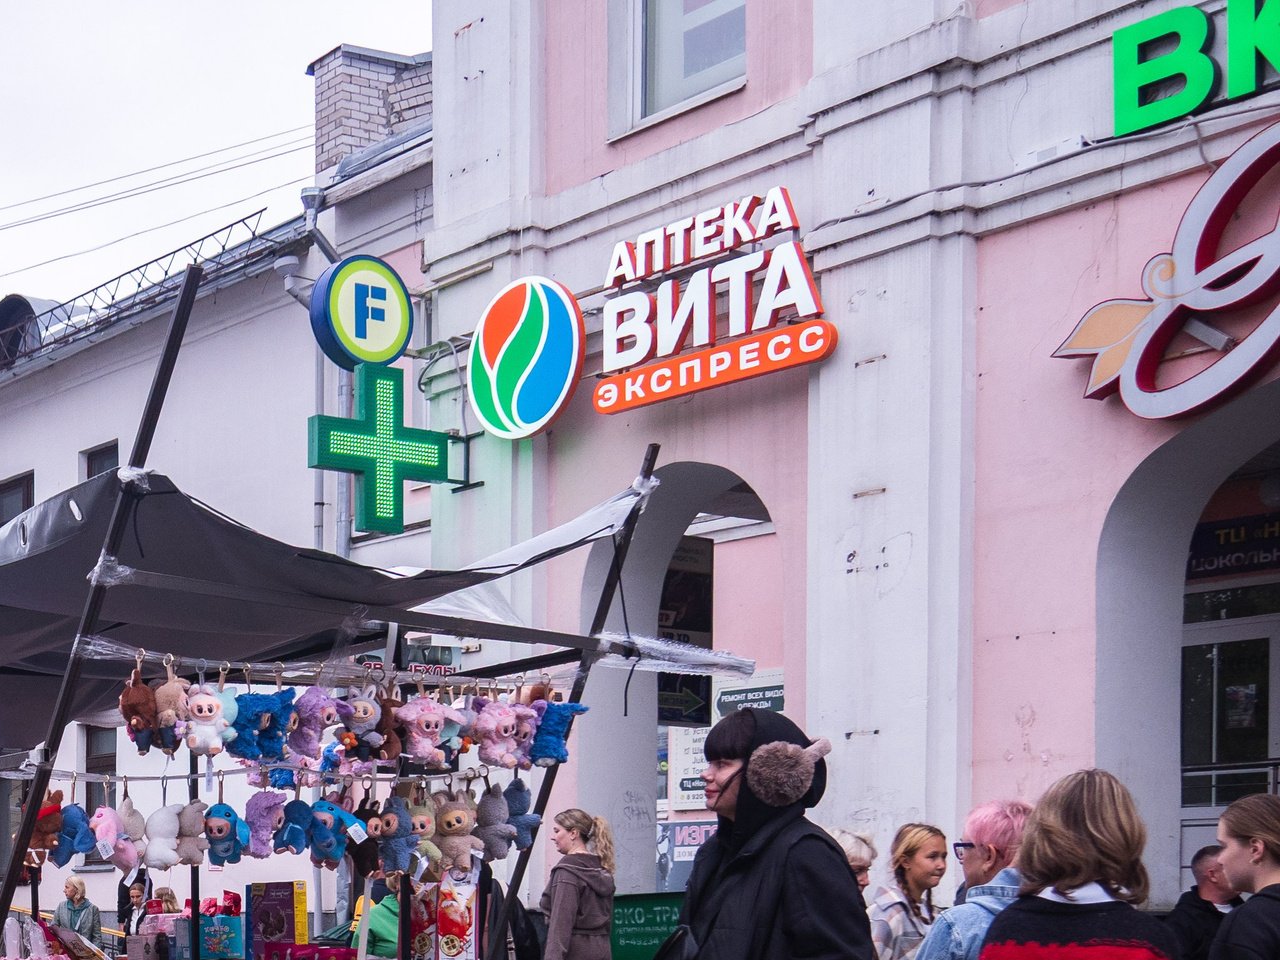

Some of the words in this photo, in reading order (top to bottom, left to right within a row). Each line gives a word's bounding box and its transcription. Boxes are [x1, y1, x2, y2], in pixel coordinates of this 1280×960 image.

[604, 186, 799, 289] АПТЕКА
[354, 283, 387, 339] F
[603, 240, 824, 373] ВИТА
[597, 325, 825, 409] ЭКСПРЕСС
[721, 693, 746, 702] РЕМОНТ
[747, 691, 763, 700] ВСЕХ
